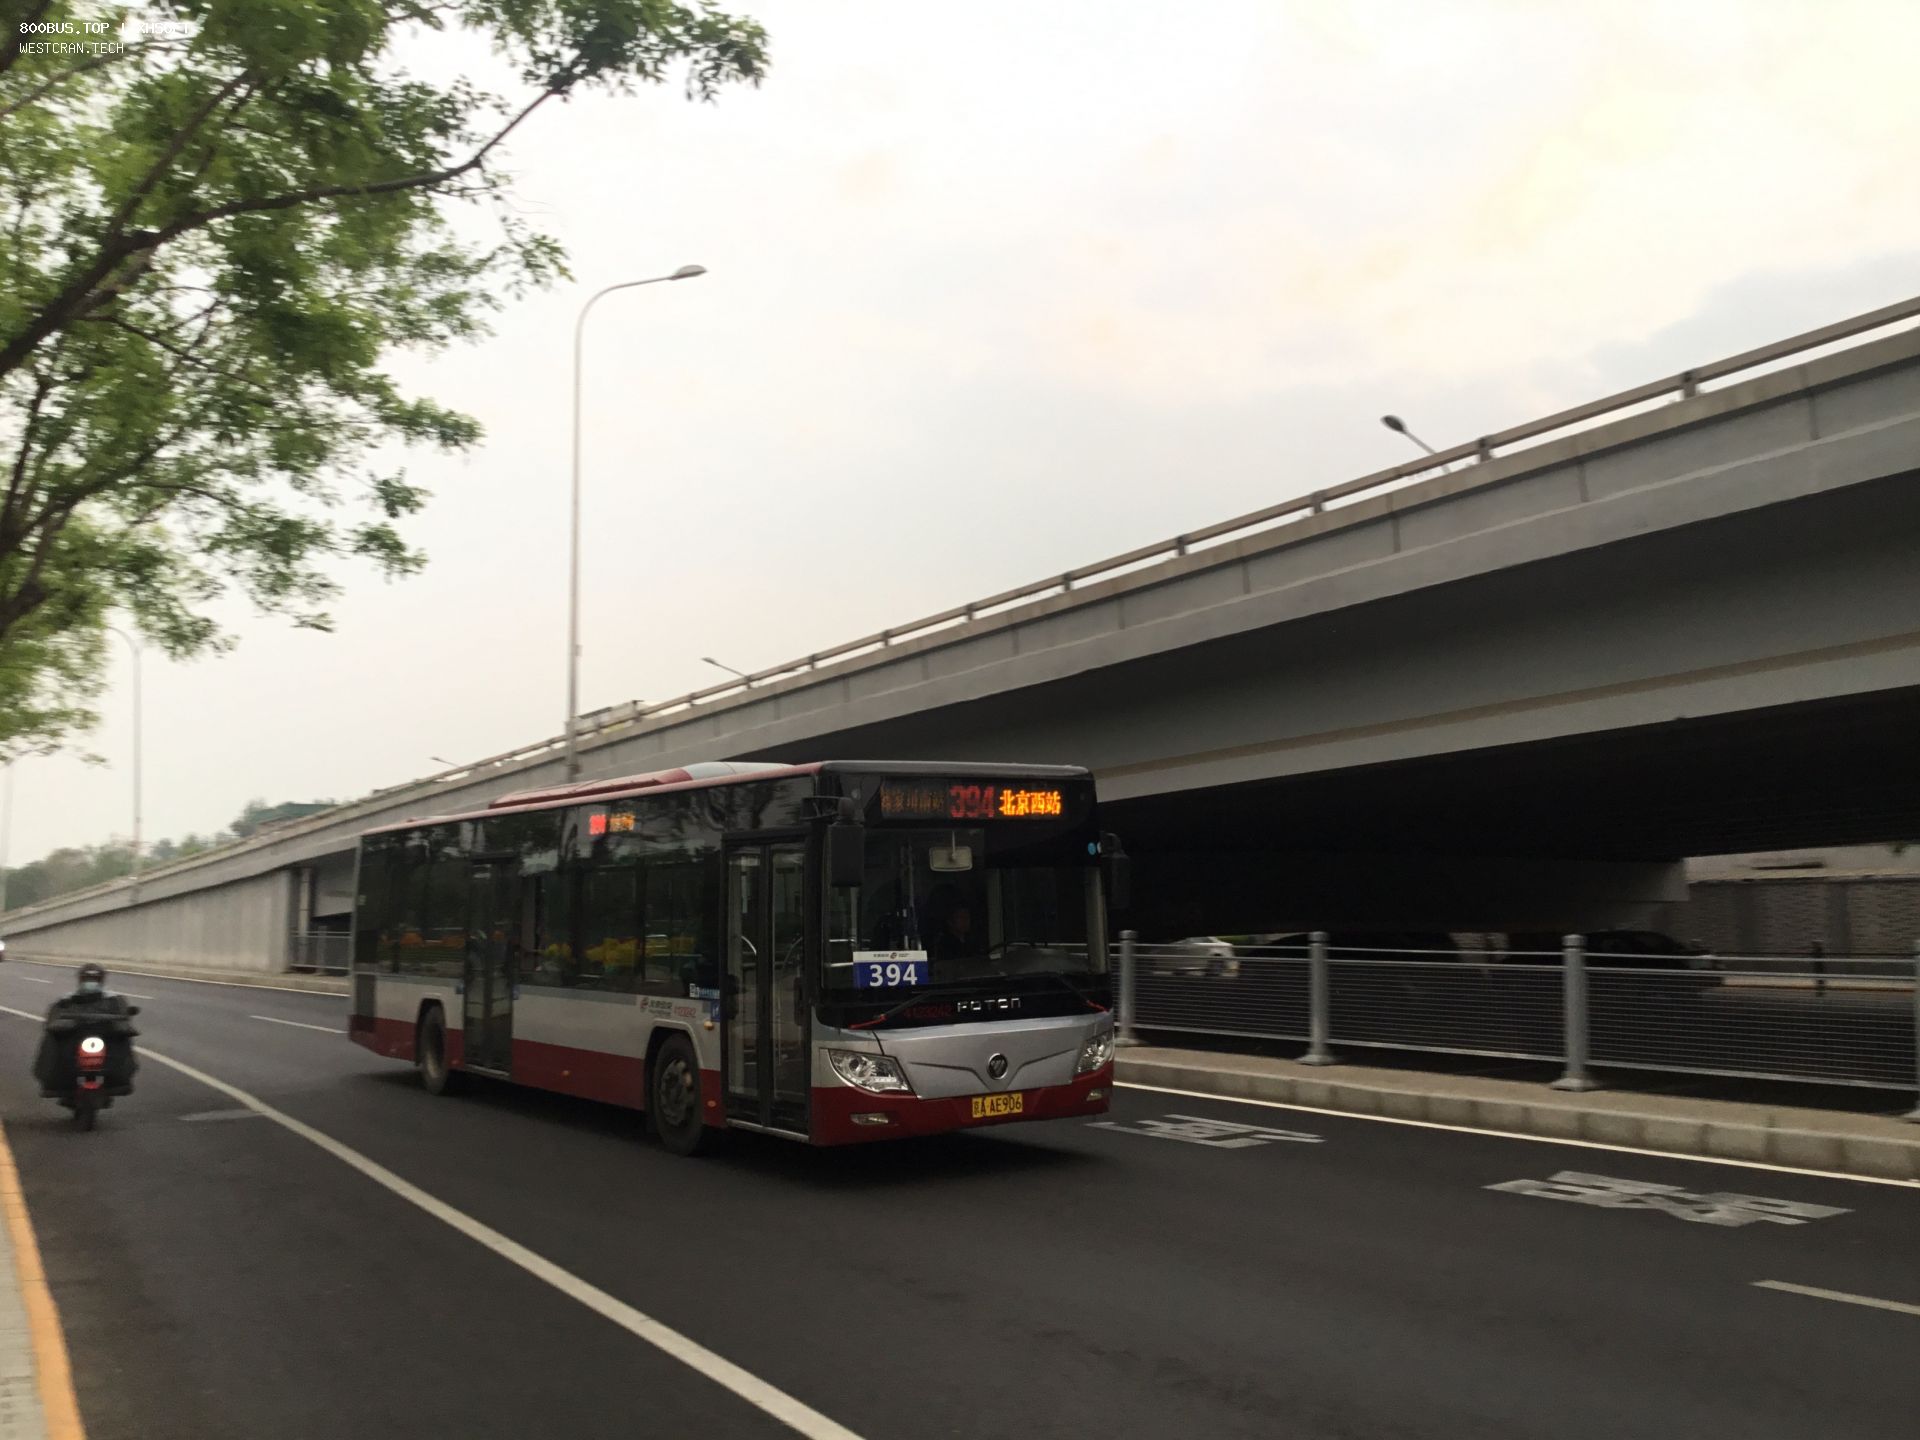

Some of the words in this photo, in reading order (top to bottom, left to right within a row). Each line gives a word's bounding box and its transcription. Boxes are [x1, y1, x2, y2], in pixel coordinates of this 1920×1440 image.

[950, 785, 994, 818] 394
[999, 790, 1061, 816] 北京西站
[869, 963, 918, 987] 394
[957, 998, 1021, 1012] FOTON
